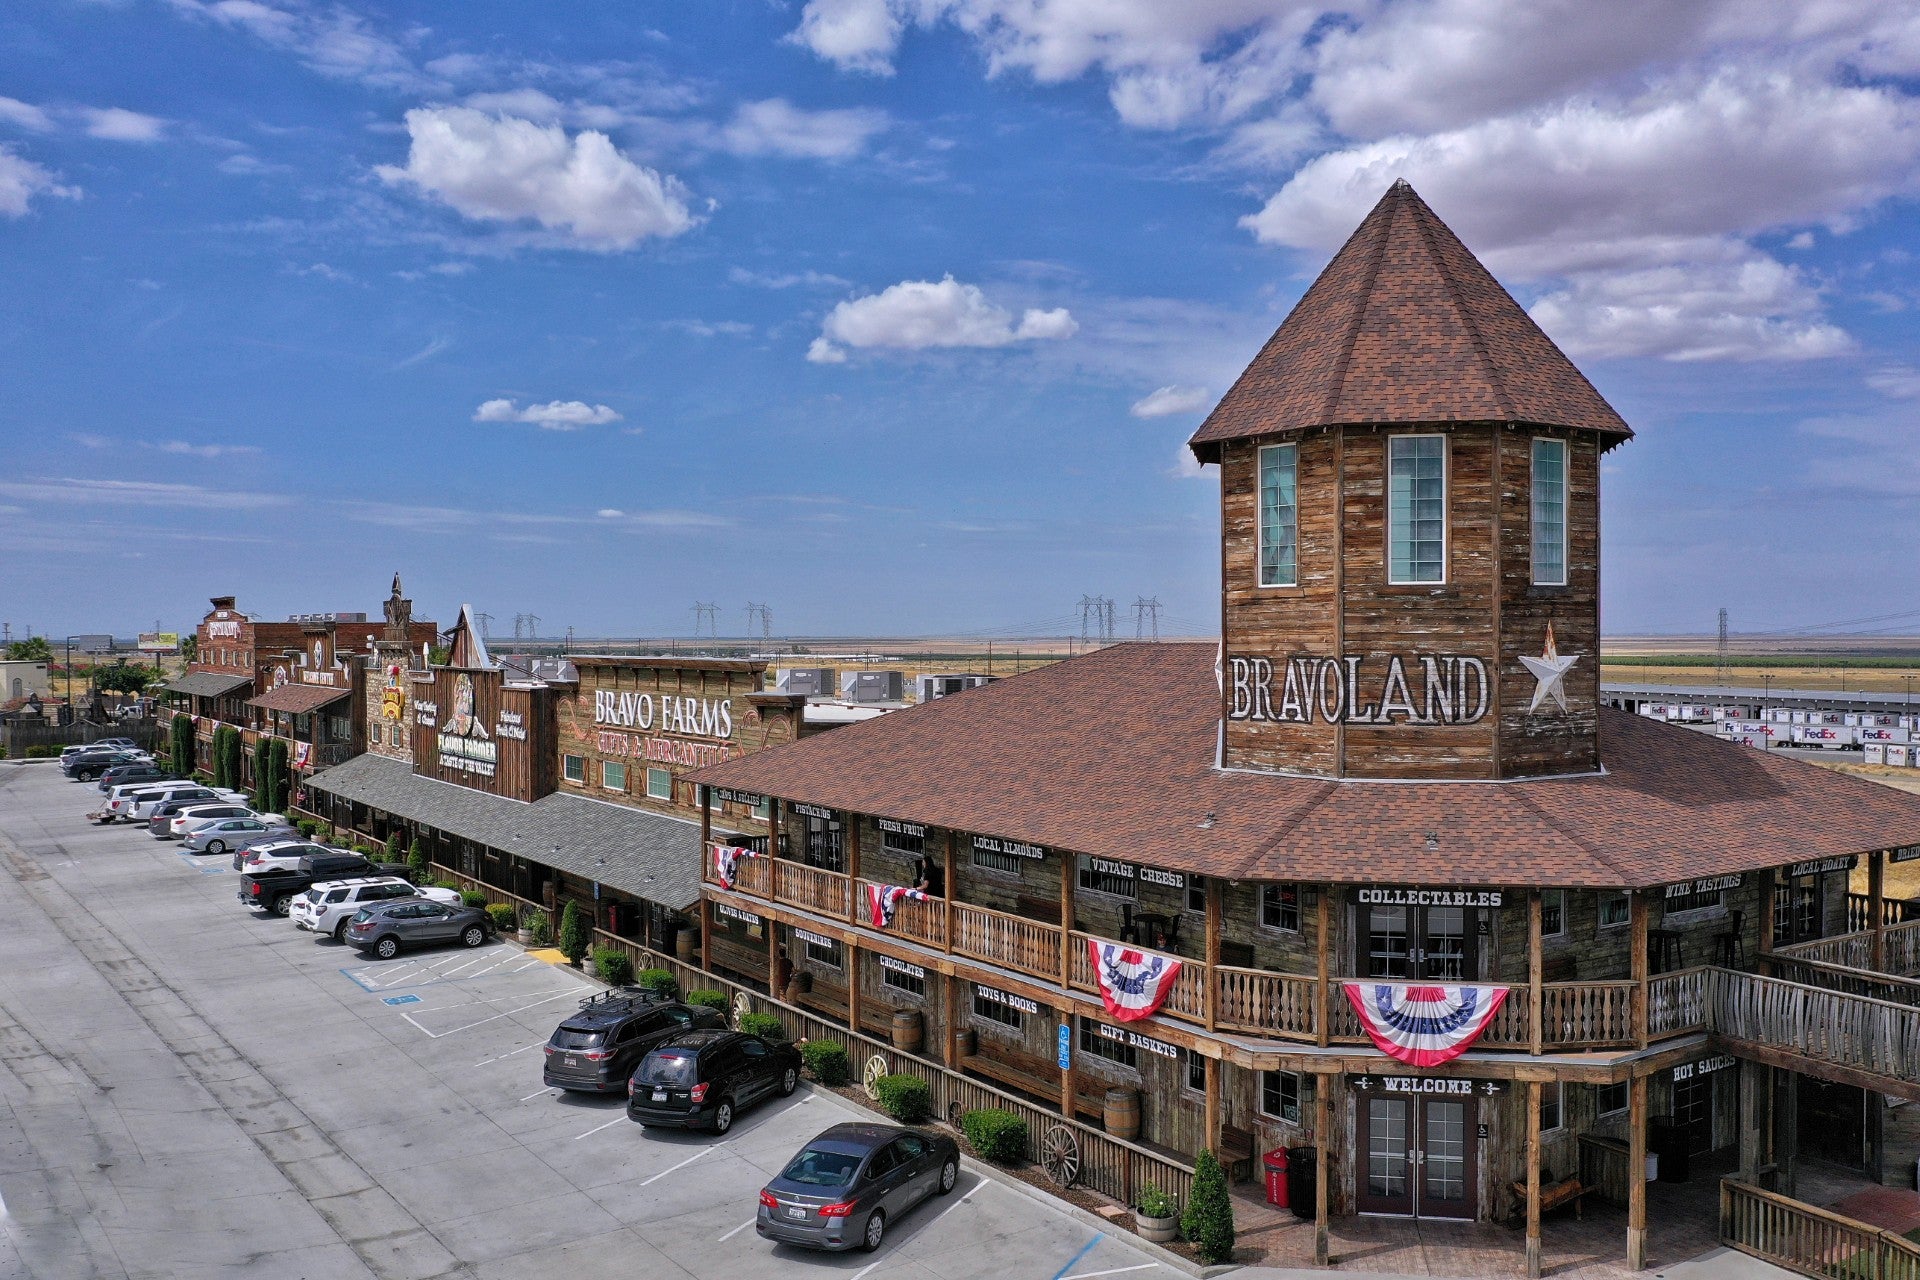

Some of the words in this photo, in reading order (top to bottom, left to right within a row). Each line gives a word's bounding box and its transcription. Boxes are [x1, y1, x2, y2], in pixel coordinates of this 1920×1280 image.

[1229, 655, 1490, 725] BRAVOLAND
[595, 690, 653, 729] BRAVO
[661, 696, 732, 738] FARMS
[1804, 728, 1836, 739] FedEx
[1862, 729, 1891, 740] FedEx
[438, 734, 464, 755] FLAVOR
[464, 738, 496, 761] FARMER
[598, 731, 629, 757] GIFTS
[632, 736, 642, 758] &
[645, 737, 729, 768] MERCANTILE
[795, 803, 831, 820] PISTACHIOS
[878, 818, 901, 834] FRESH
[903, 823, 925, 838] FRUIT
[973, 836, 1001, 852] LOCAL
[1003, 841, 1043, 860] ALMONDS
[1091, 857, 1134, 878] VINTAGE
[1140, 867, 1184, 888] CHEESE
[1791, 861, 1819, 877] LOCAL
[1820, 856, 1851, 872] HONEY
[1358, 889, 1502, 907] COLLECTABLES
[1665, 882, 1691, 899] WINE
[1695, 874, 1742, 894] TASTINGS
[879, 955, 925, 979] CHOCOLATES
[977, 985, 1000, 1002] TOYS
[1000, 992, 1007, 1003] &
[1008, 996, 1038, 1014] BOOKS
[1100, 1023, 1125, 1042] GIFT
[1129, 1032, 1177, 1059] BASKETS
[1673, 1063, 1694, 1082] HOT
[1698, 1054, 1736, 1075] SAUCES
[1383, 1077, 1472, 1094] WELCOME
